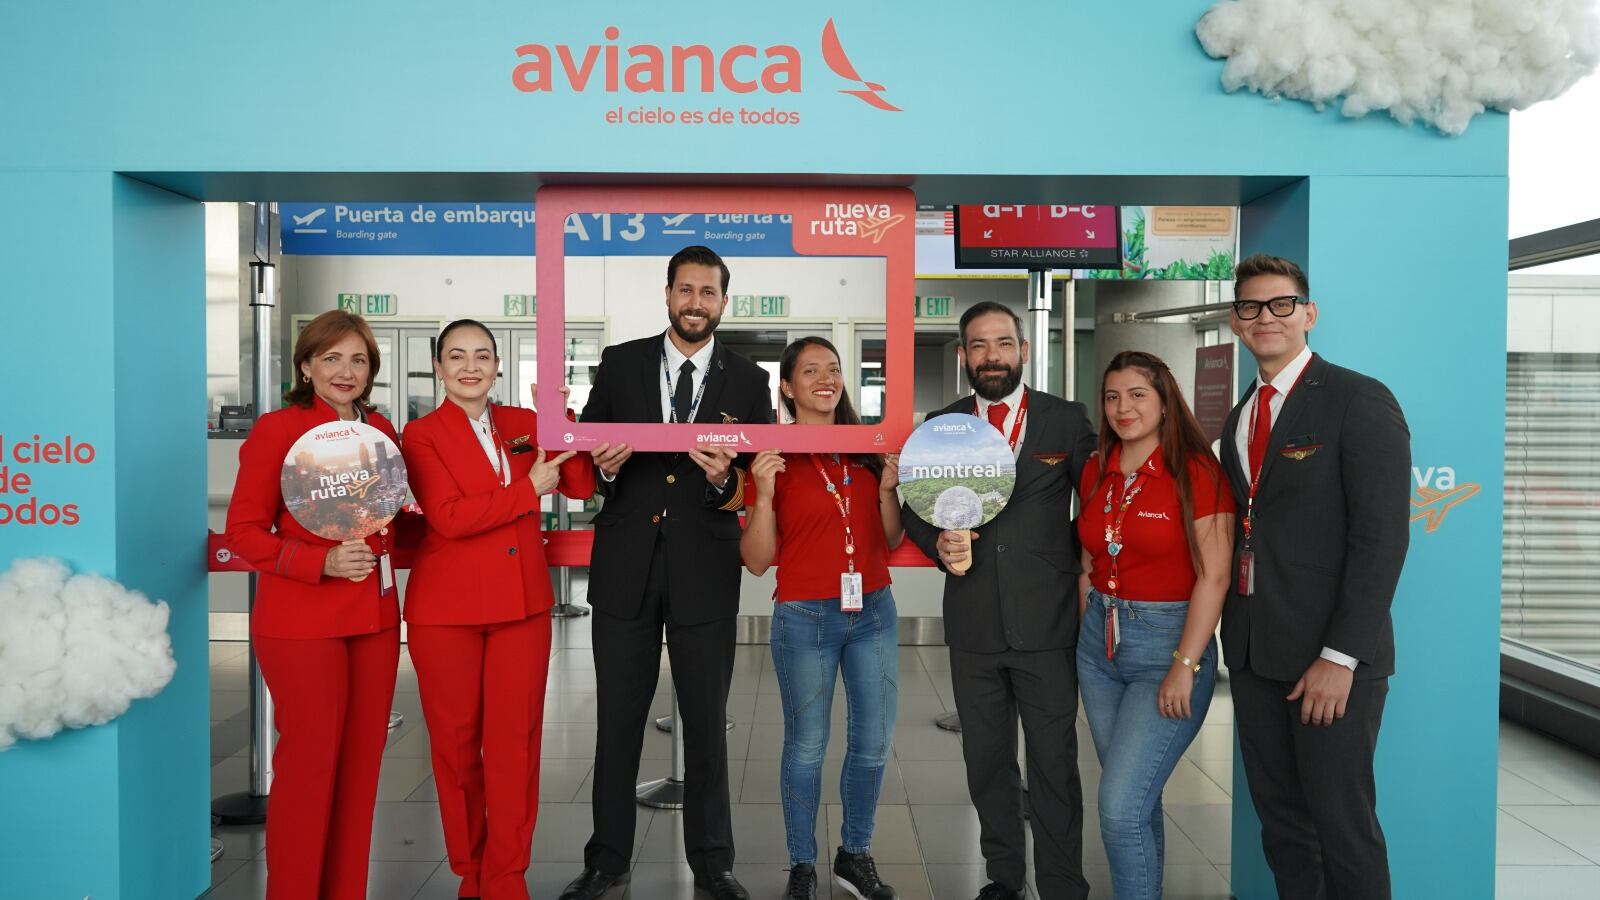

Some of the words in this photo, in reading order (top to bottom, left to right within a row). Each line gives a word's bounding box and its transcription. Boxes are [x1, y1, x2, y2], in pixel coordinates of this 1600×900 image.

[511, 26, 802, 94] avianca
[605, 106, 622, 123] el
[628, 106, 676, 124] cielo
[680, 110, 704, 124] es
[708, 106, 735, 124] de
[739, 106, 801, 124] todos
[335, 205, 404, 223] Puerta
[410, 205, 437, 223] de
[825, 203, 890, 219] nueva
[336, 229, 375, 241] Boarding
[377, 230, 398, 241] gate
[564, 213, 646, 241] A13
[704, 230, 744, 241] Boarding
[745, 231, 766, 241] gate
[811, 218, 857, 236] ruta
[990, 249, 1018, 257] STAR
[1021, 249, 1076, 258] ALLIANCE
[366, 295, 390, 313] EXIT
[760, 296, 784, 315] EXIT
[926, 297, 951, 316] EXIT
[314, 427, 350, 441] avianca
[933, 422, 967, 432] avianca
[696, 432, 739, 443] avianca
[13, 434, 96, 464] cielo
[319, 469, 369, 487] nueva
[912, 460, 1001, 478] montreal
[310, 483, 347, 501] ruta
[1137, 510, 1162, 519] Avianca
